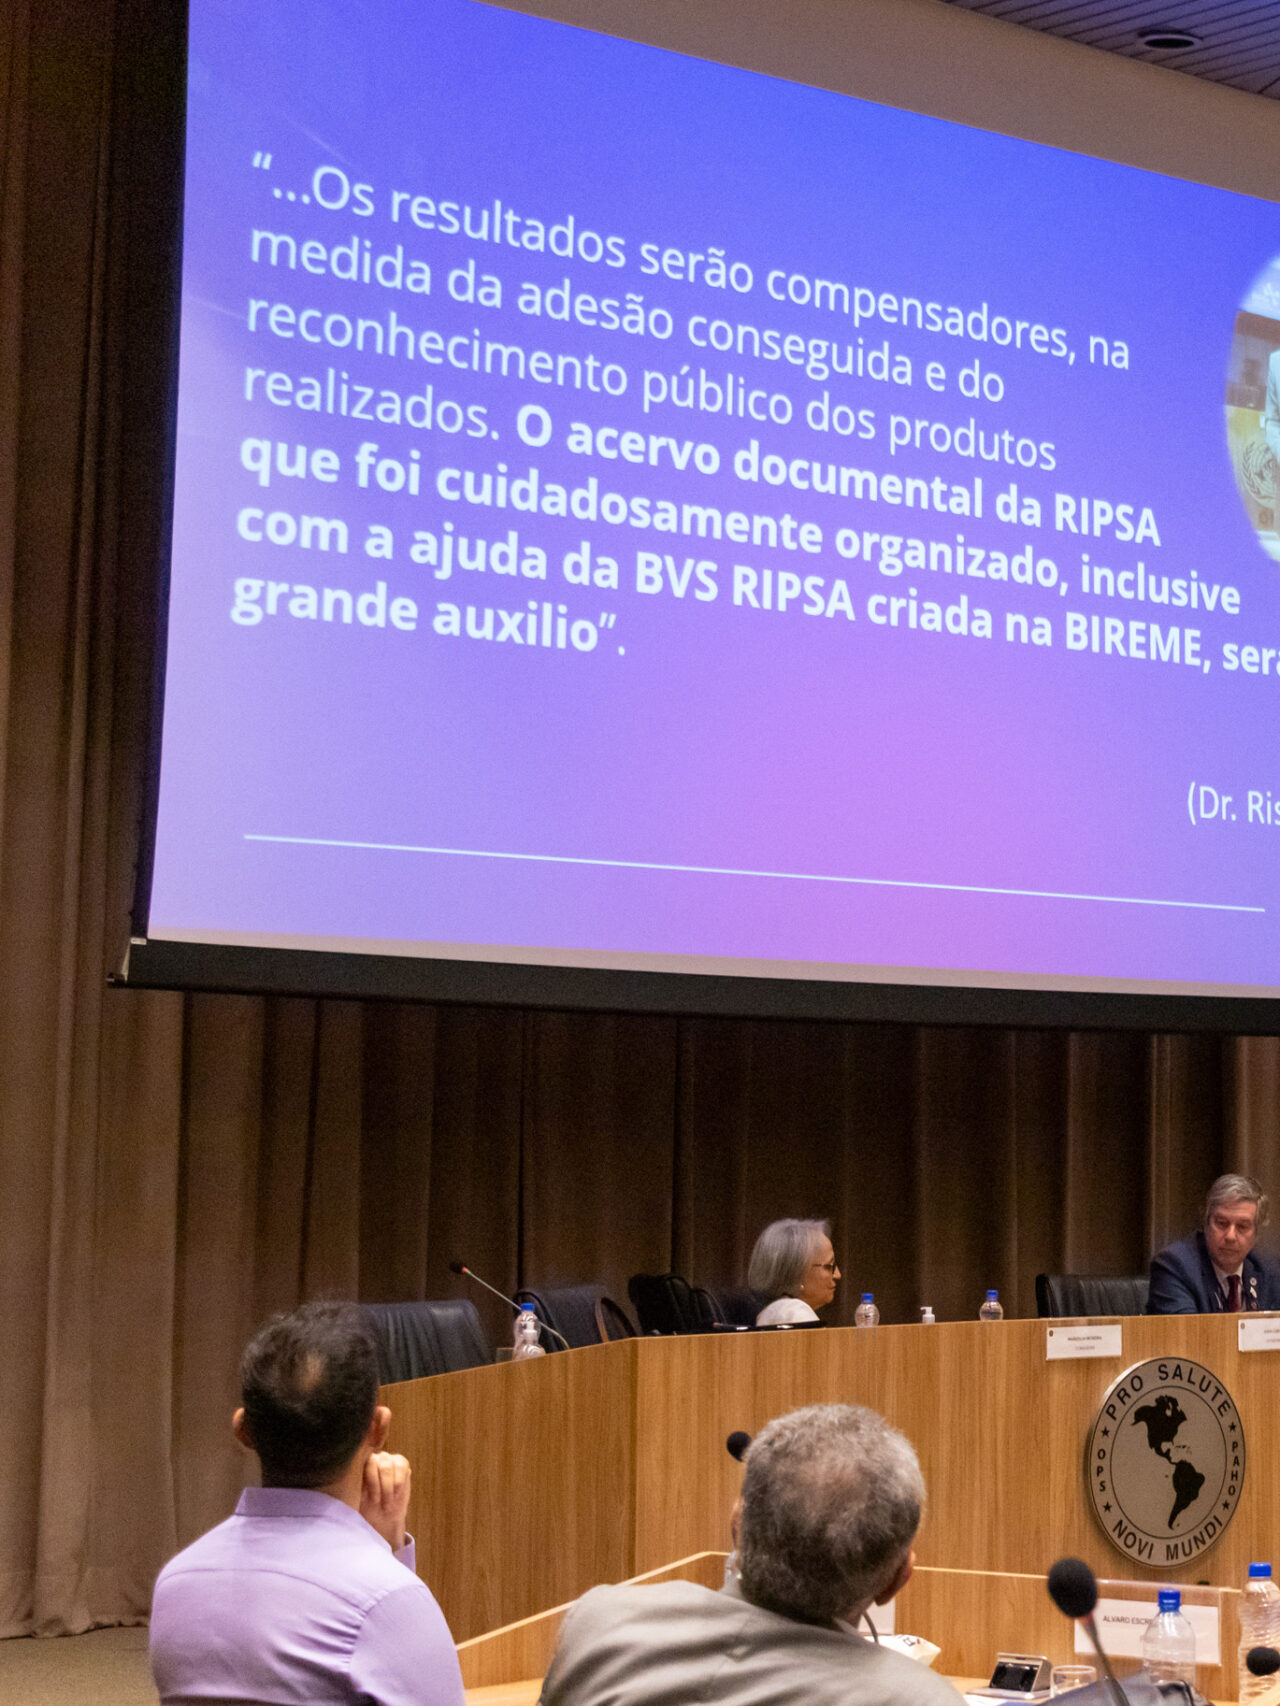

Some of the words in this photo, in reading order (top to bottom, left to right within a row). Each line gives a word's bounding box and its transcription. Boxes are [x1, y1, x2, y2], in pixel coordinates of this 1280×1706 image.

[251, 229, 431, 295] medida
[447, 258, 502, 309] da
[517, 278, 674, 340] adesão
[687, 315, 913, 387] conseguida
[925, 361, 946, 392] e
[958, 358, 1005, 403] do
[391, 190, 626, 268] resultados
[640, 243, 754, 293] serão
[767, 268, 1076, 362] compensadores,
[1089, 335, 1129, 370] na
[247, 297, 628, 395] reconhecimento
[643, 365, 793, 425] público
[806, 390, 876, 440] dos
[889, 414, 1057, 471] produtos
[245, 367, 499, 441] realizados.
[516, 404, 553, 447] O
[566, 422, 721, 475] acervo
[734, 439, 983, 518] documental
[995, 483, 1042, 528] da
[1055, 493, 1161, 547] RIPSA
[241, 437, 340, 487] que
[354, 441, 421, 496] foi
[436, 463, 823, 554] cuidadosamente
[835, 528, 1069, 597] organizado,
[1081, 553, 1241, 615] inclusive
[231, 578, 418, 631] grande
[237, 508, 349, 554] com
[364, 525, 393, 560] a
[409, 521, 547, 580] ajuda
[562, 540, 619, 590] da
[636, 551, 719, 602] BVS
[733, 564, 856, 621] RIPSA
[867, 587, 993, 639] criada
[1006, 612, 1052, 647] na
[1066, 611, 1211, 674] BIREME,
[1187, 781, 1237, 825] (Dr.
[1105, 1374, 1144, 1421] PRO
[1158, 1364, 1231, 1418] SALUTE
[1096, 1448, 1106, 1492] OPS
[1227, 1441, 1240, 1496] PAHO
[1113, 1519, 1154, 1560] NOVI
[1165, 1515, 1224, 1561] MUNDI
